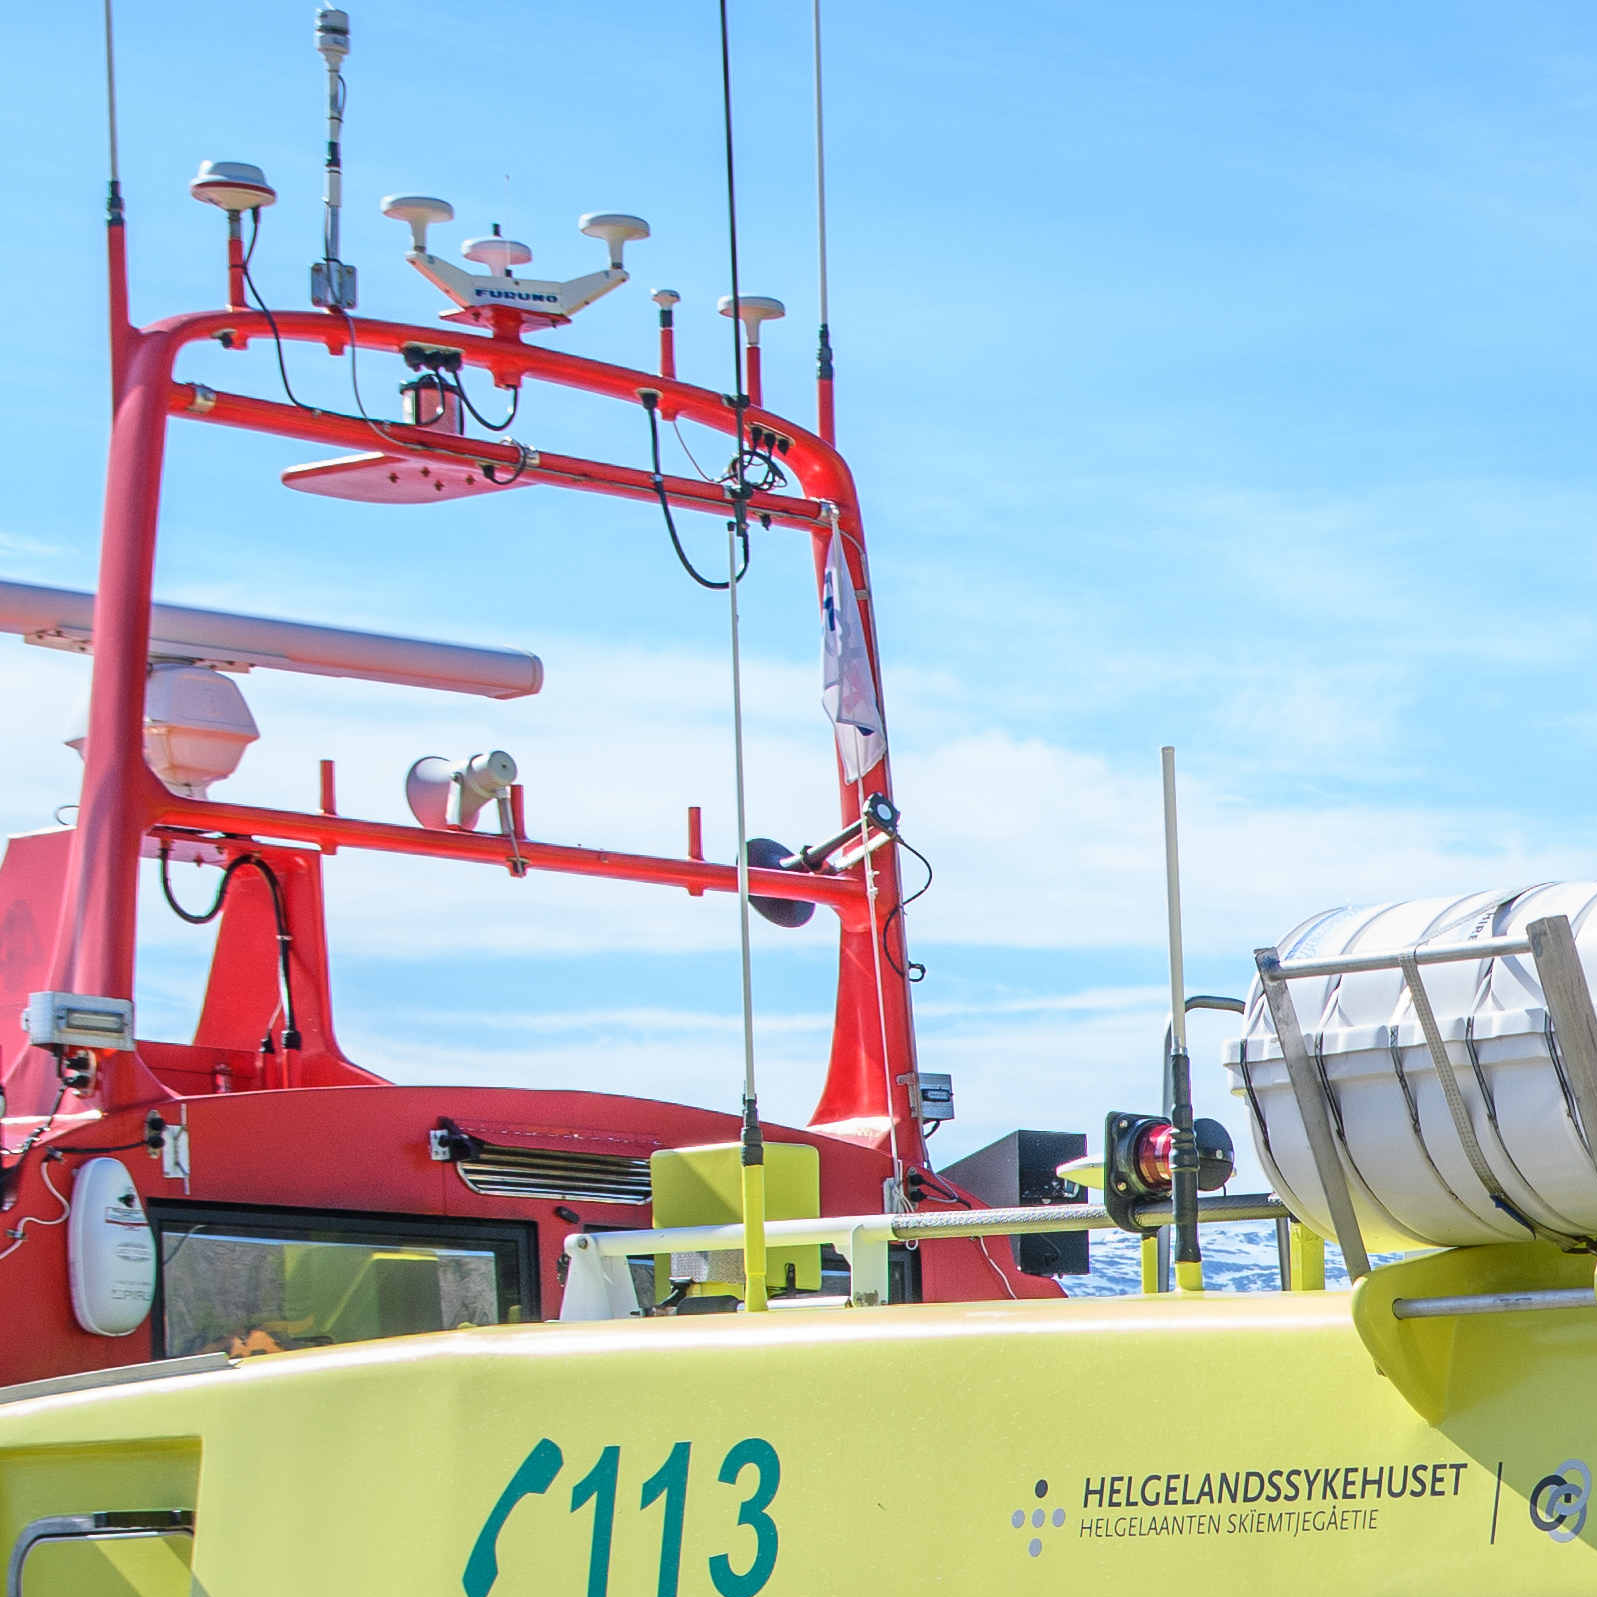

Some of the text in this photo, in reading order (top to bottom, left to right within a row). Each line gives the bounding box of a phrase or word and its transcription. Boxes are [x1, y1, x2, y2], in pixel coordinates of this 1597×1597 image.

[475, 288, 559, 303] FURUNO
[1083, 1463, 1468, 1508] HELGELANDSSYKEHUSET
[1080, 1505, 1379, 1538] HELGELAANTEN SKÏEMTJEGÅETIE
